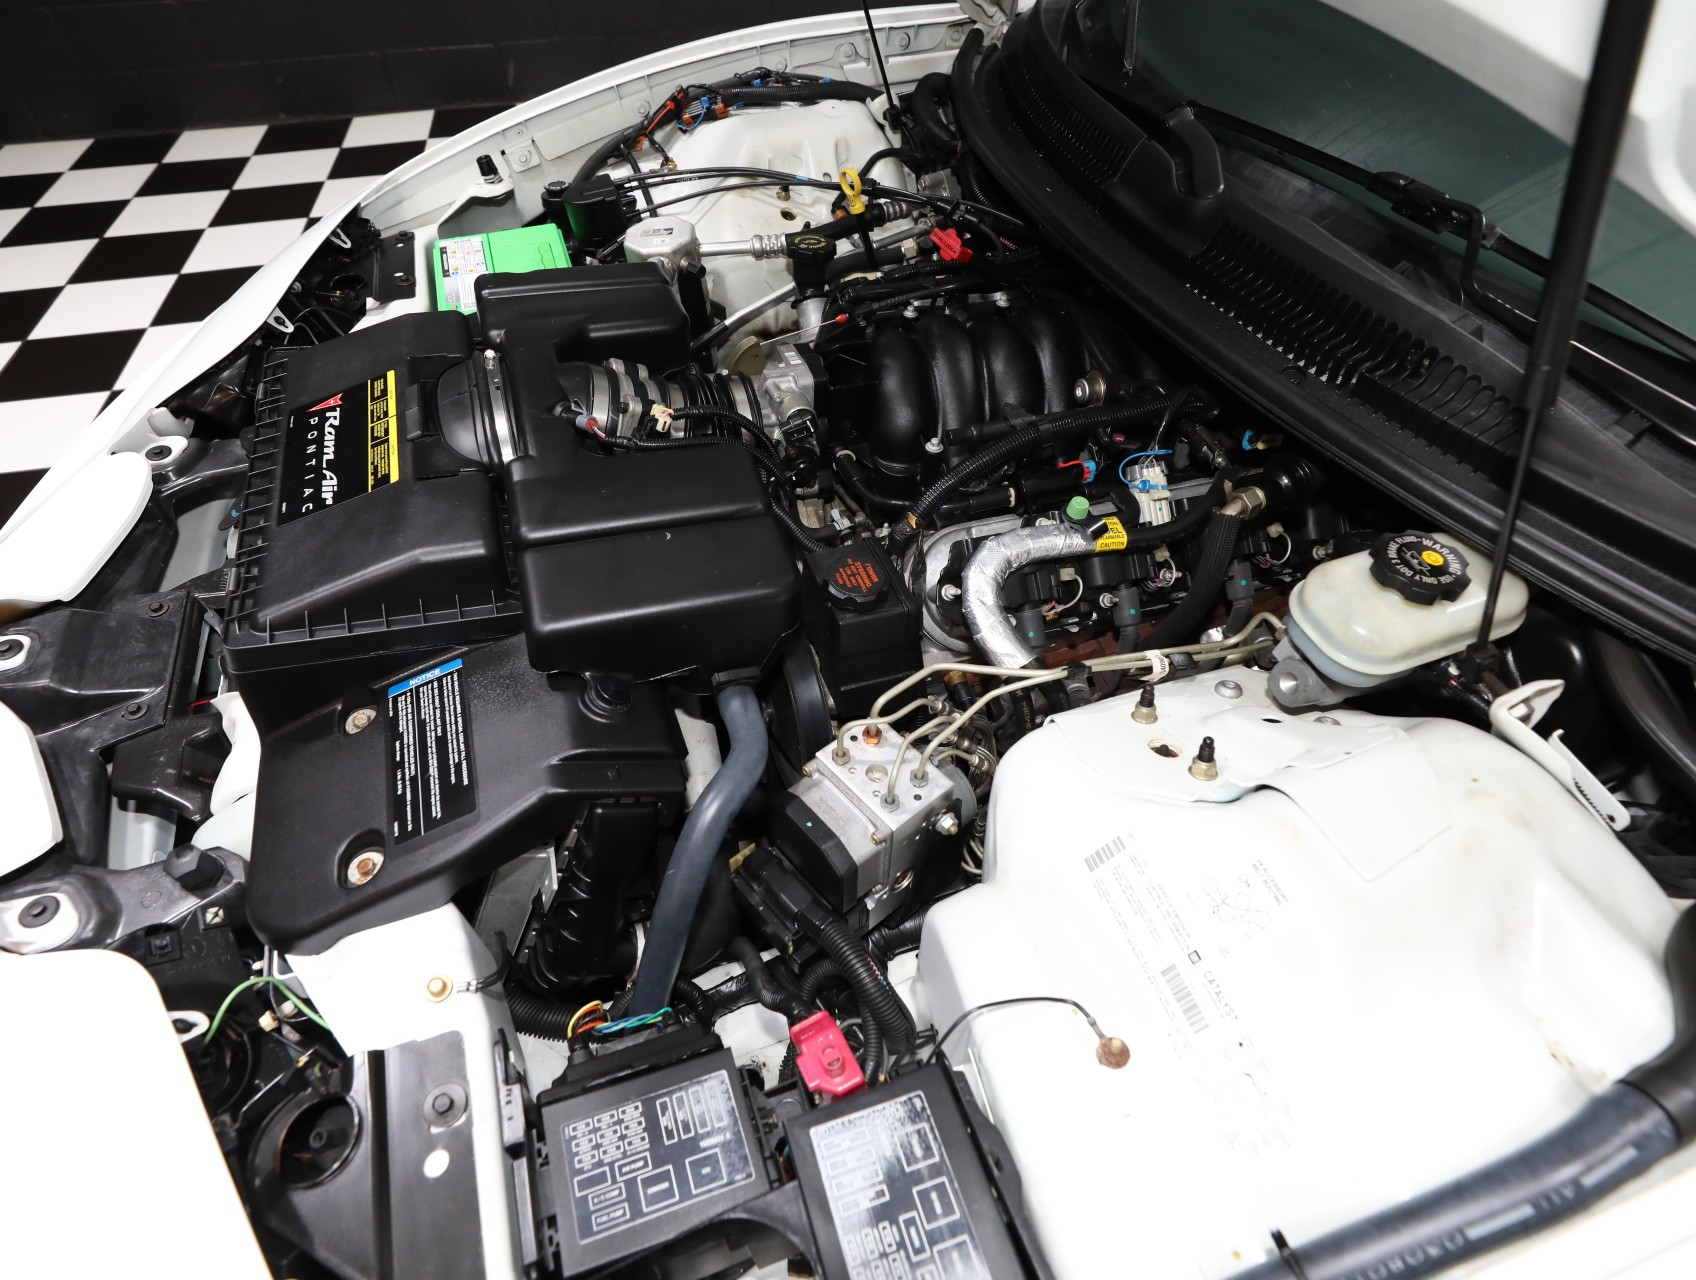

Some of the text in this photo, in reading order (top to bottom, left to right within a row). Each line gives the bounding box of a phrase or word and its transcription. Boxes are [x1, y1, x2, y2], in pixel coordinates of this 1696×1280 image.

[302, 416, 318, 513] PONTIAC
[322, 408, 340, 505] Ram Air
[1395, 536, 1417, 545] FLUID
[1387, 542, 1400, 559] BRAKE
[1422, 538, 1462, 575] WARNING
[1396, 565, 1413, 577] DOT
[1414, 574, 1438, 584] ONLY
[1437, 575, 1455, 584] USE
[410, 668, 441, 686] NOTICE
[1201, 969, 1239, 1023] CATALYST
